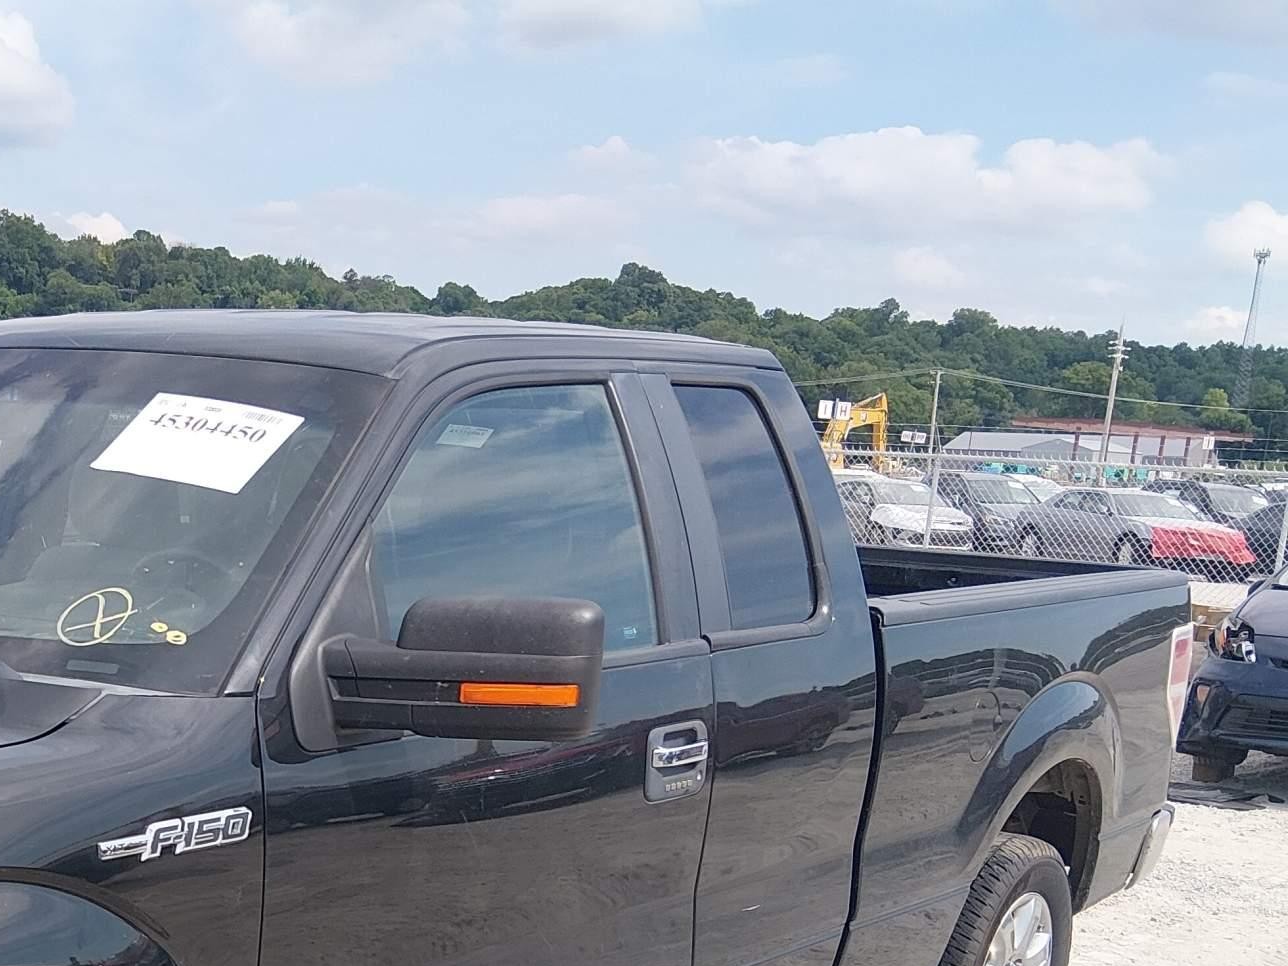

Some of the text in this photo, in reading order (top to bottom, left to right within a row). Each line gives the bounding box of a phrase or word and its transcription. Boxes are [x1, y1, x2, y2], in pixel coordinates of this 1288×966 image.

[839, 404, 848, 417] H
[149, 412, 268, 443] 45304450
[141, 807, 252, 861] F-150
